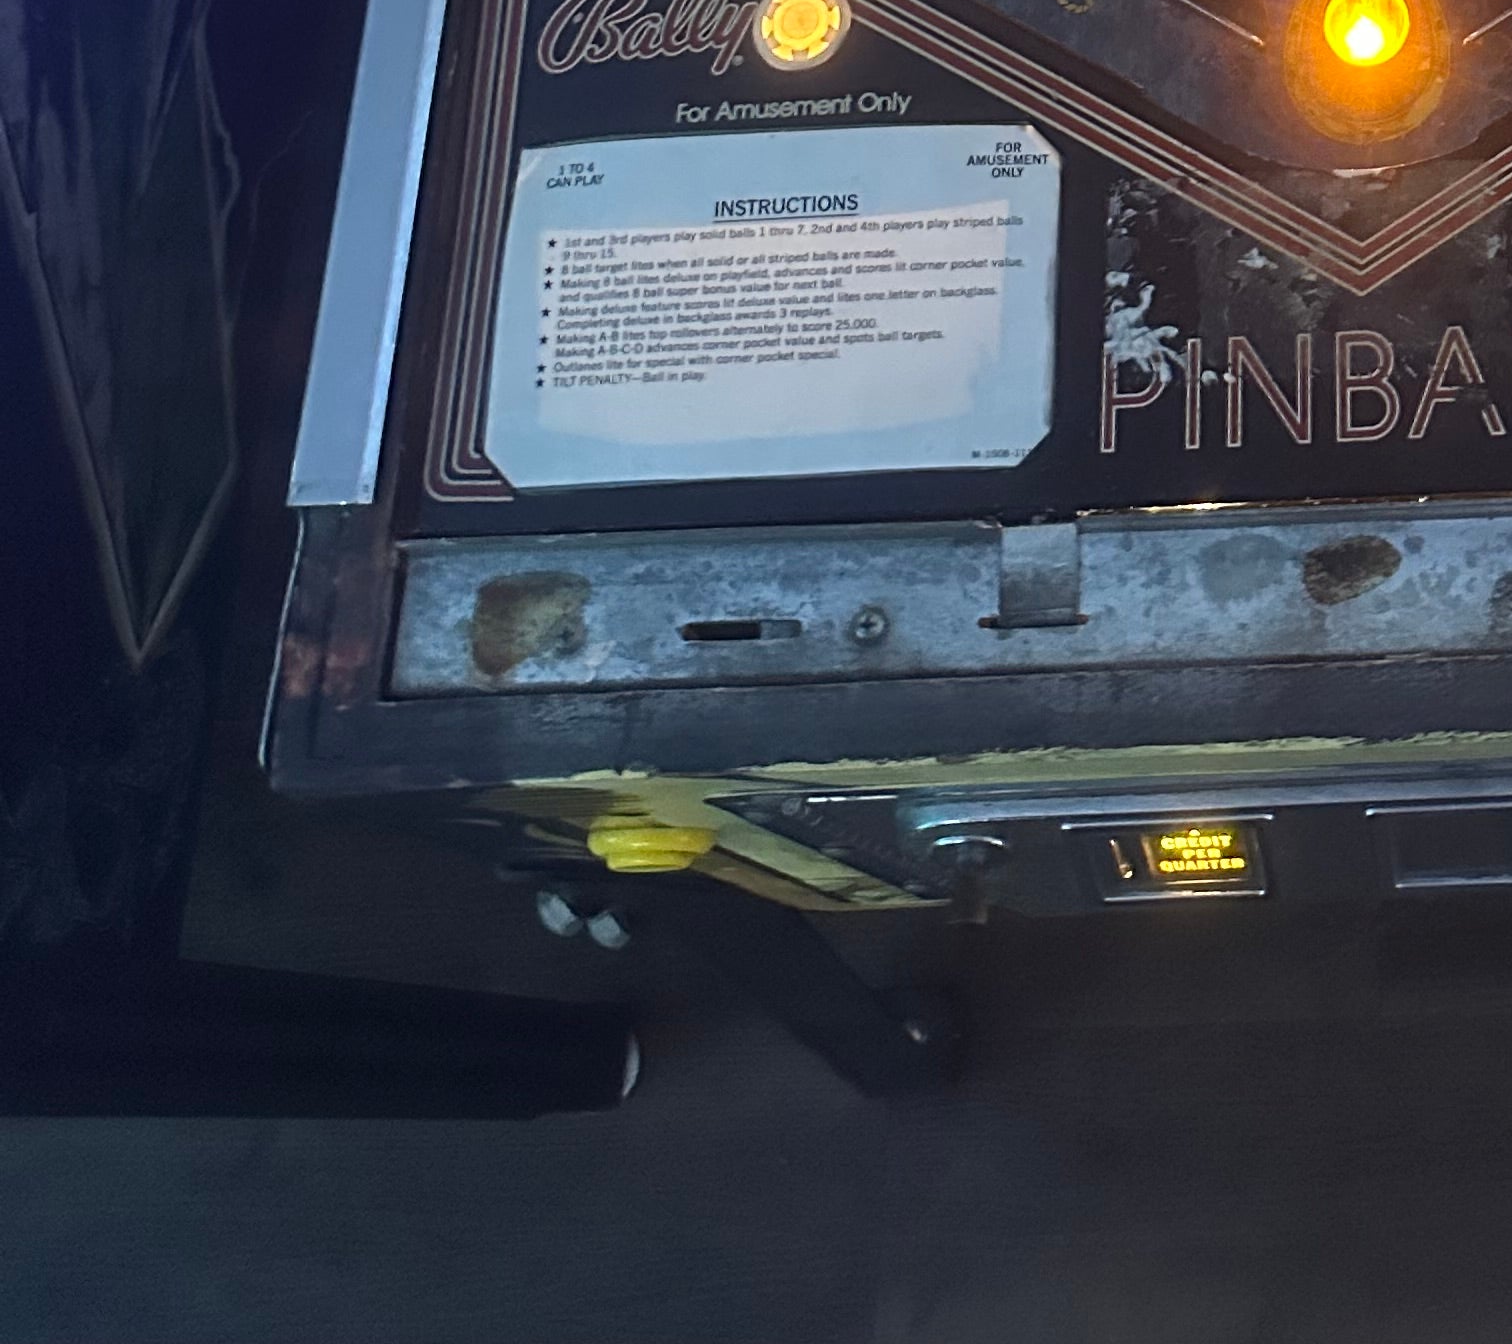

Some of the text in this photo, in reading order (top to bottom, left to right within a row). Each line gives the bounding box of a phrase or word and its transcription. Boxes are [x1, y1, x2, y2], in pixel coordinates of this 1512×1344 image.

[676, 90, 912, 124] For Amusement Only
[994, 141, 1023, 154] FOR
[966, 154, 1049, 166] AMUSEMENT
[568, 164, 582, 175] TO
[585, 162, 595, 174] 4
[991, 166, 1024, 179] ONLY
[546, 173, 604, 189] CAN PLAY
[714, 193, 859, 218] INSTRUCTIONS
[1160, 835, 1232, 850] CREDIT
[1182, 848, 1221, 860] PER
[1159, 857, 1245, 872] QUARTER
